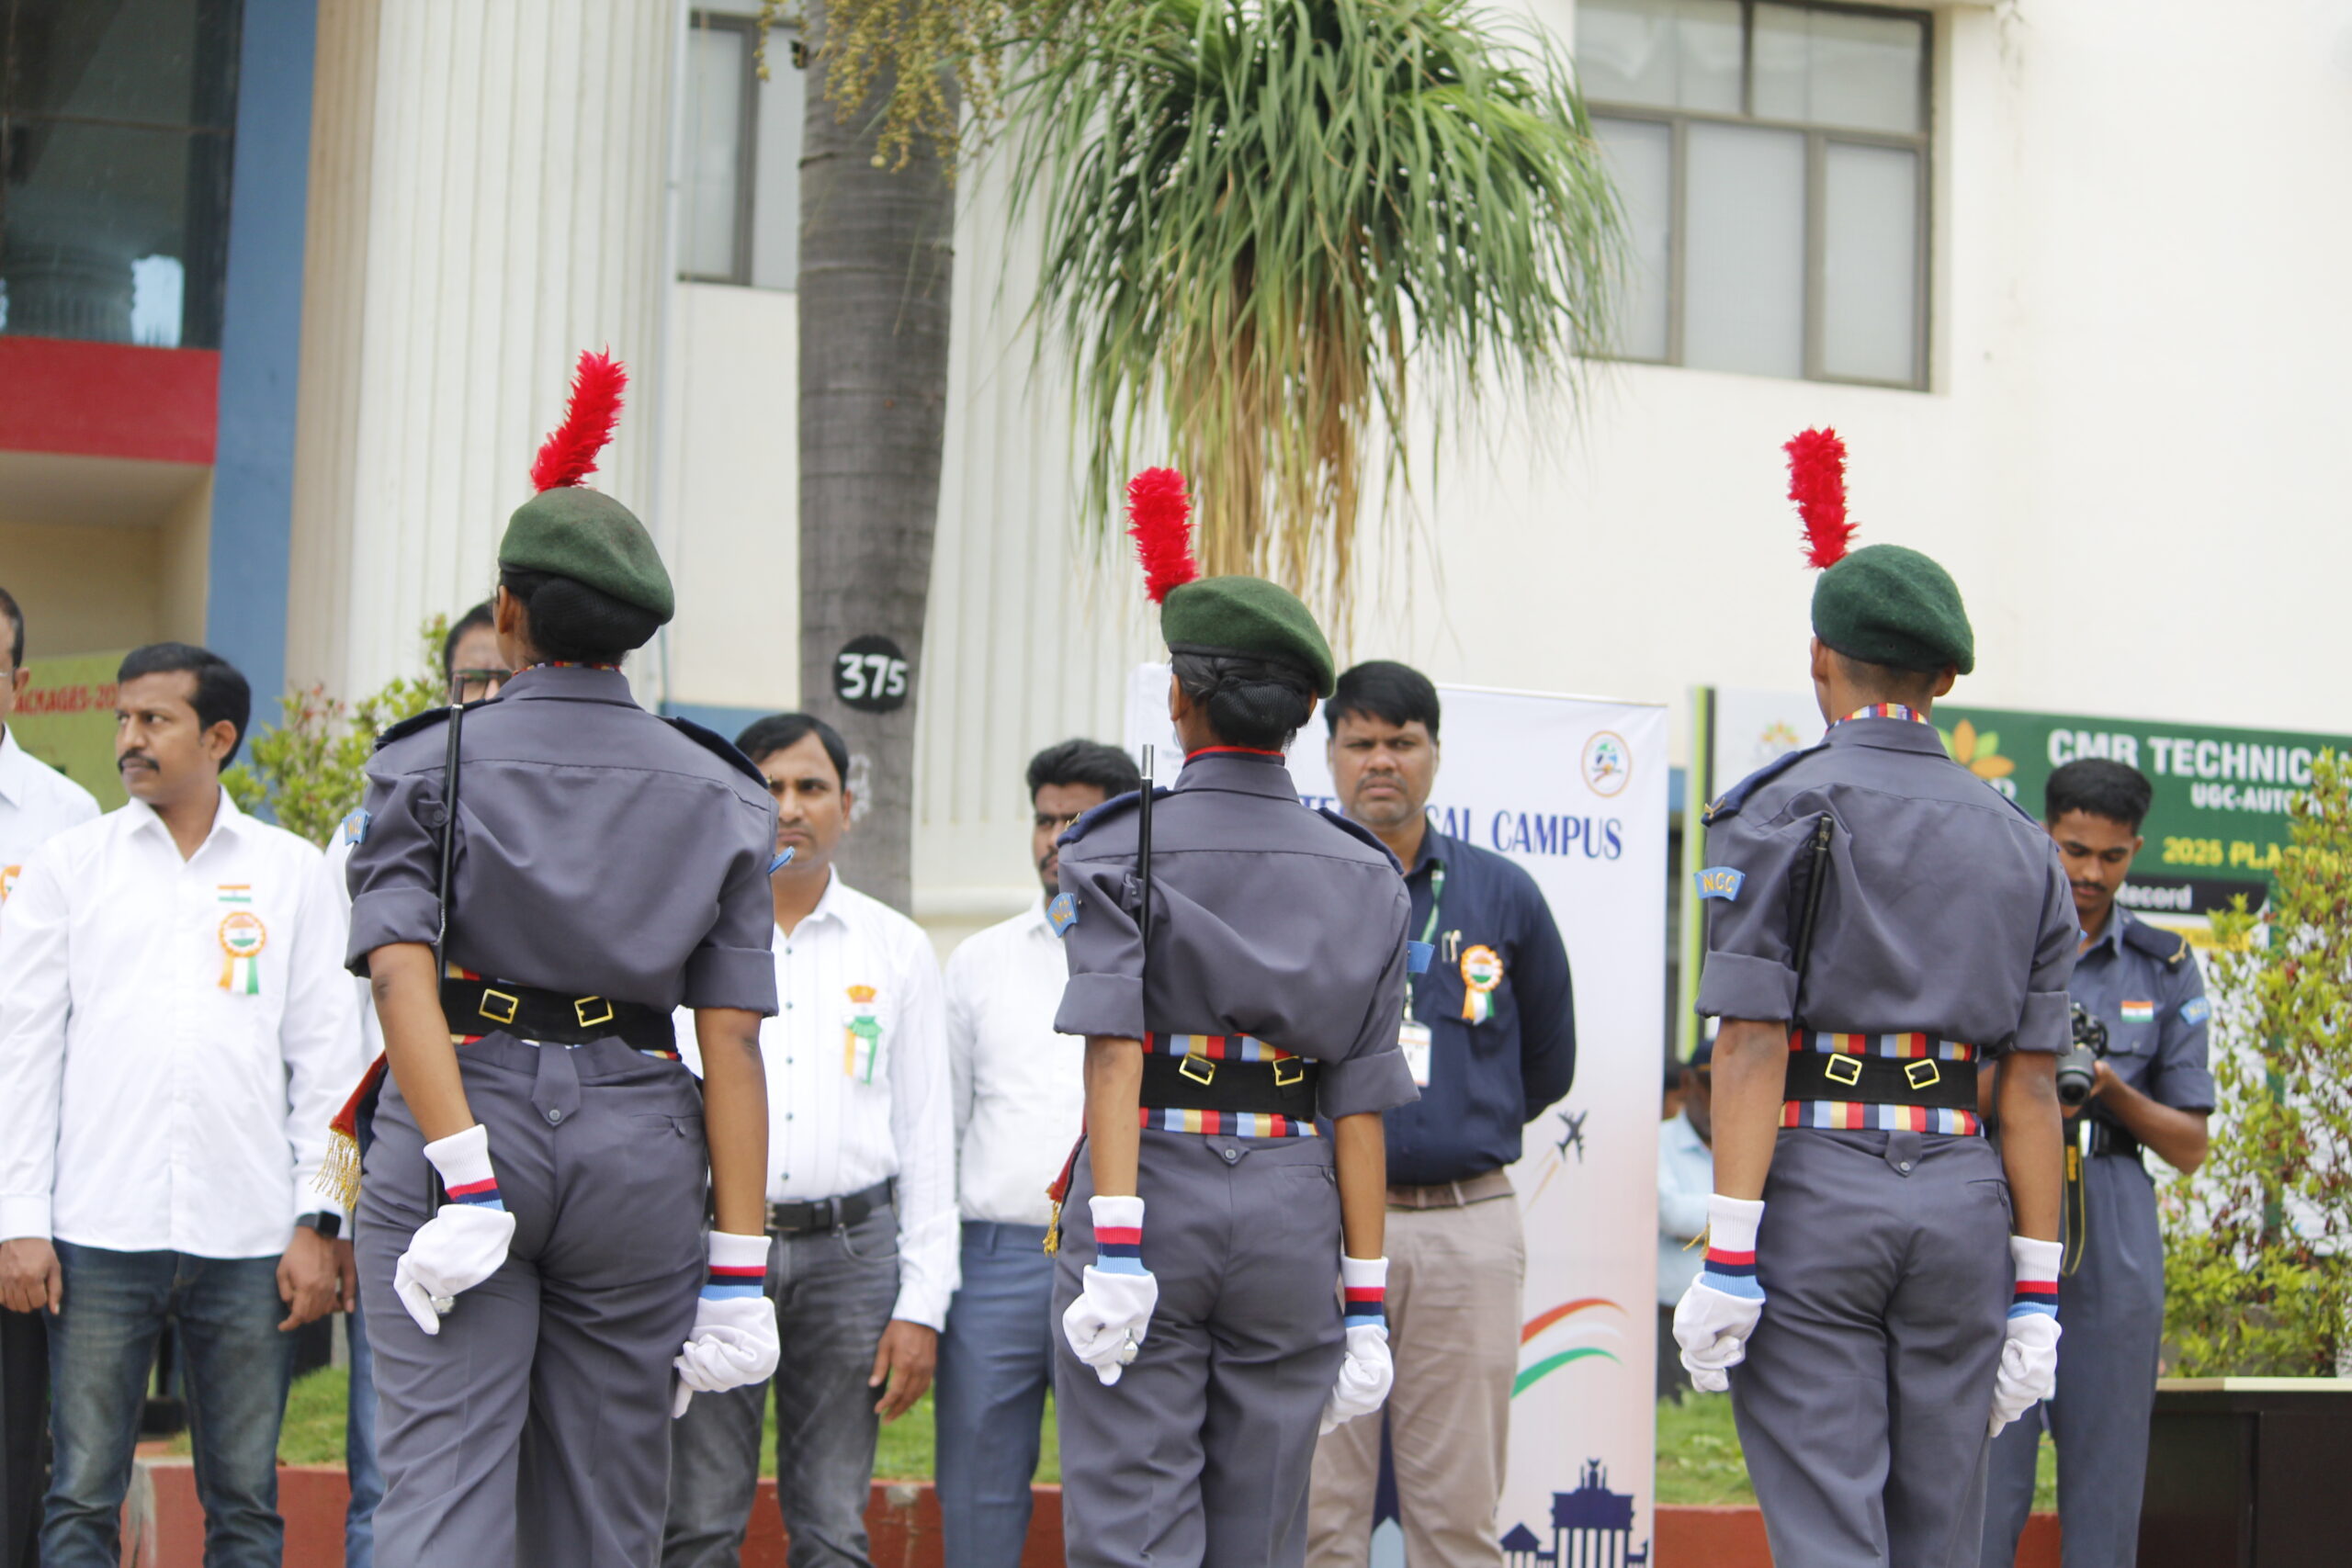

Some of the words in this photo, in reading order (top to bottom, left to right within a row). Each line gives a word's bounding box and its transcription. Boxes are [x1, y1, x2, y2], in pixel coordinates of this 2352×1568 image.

[839, 653, 909, 700] 375
[2047, 728, 2139, 771] CMR
[2148, 736, 2352, 788] TECHNIC
[1492, 810, 1623, 860] CAMPUS
[1702, 872, 1736, 894] NCC
